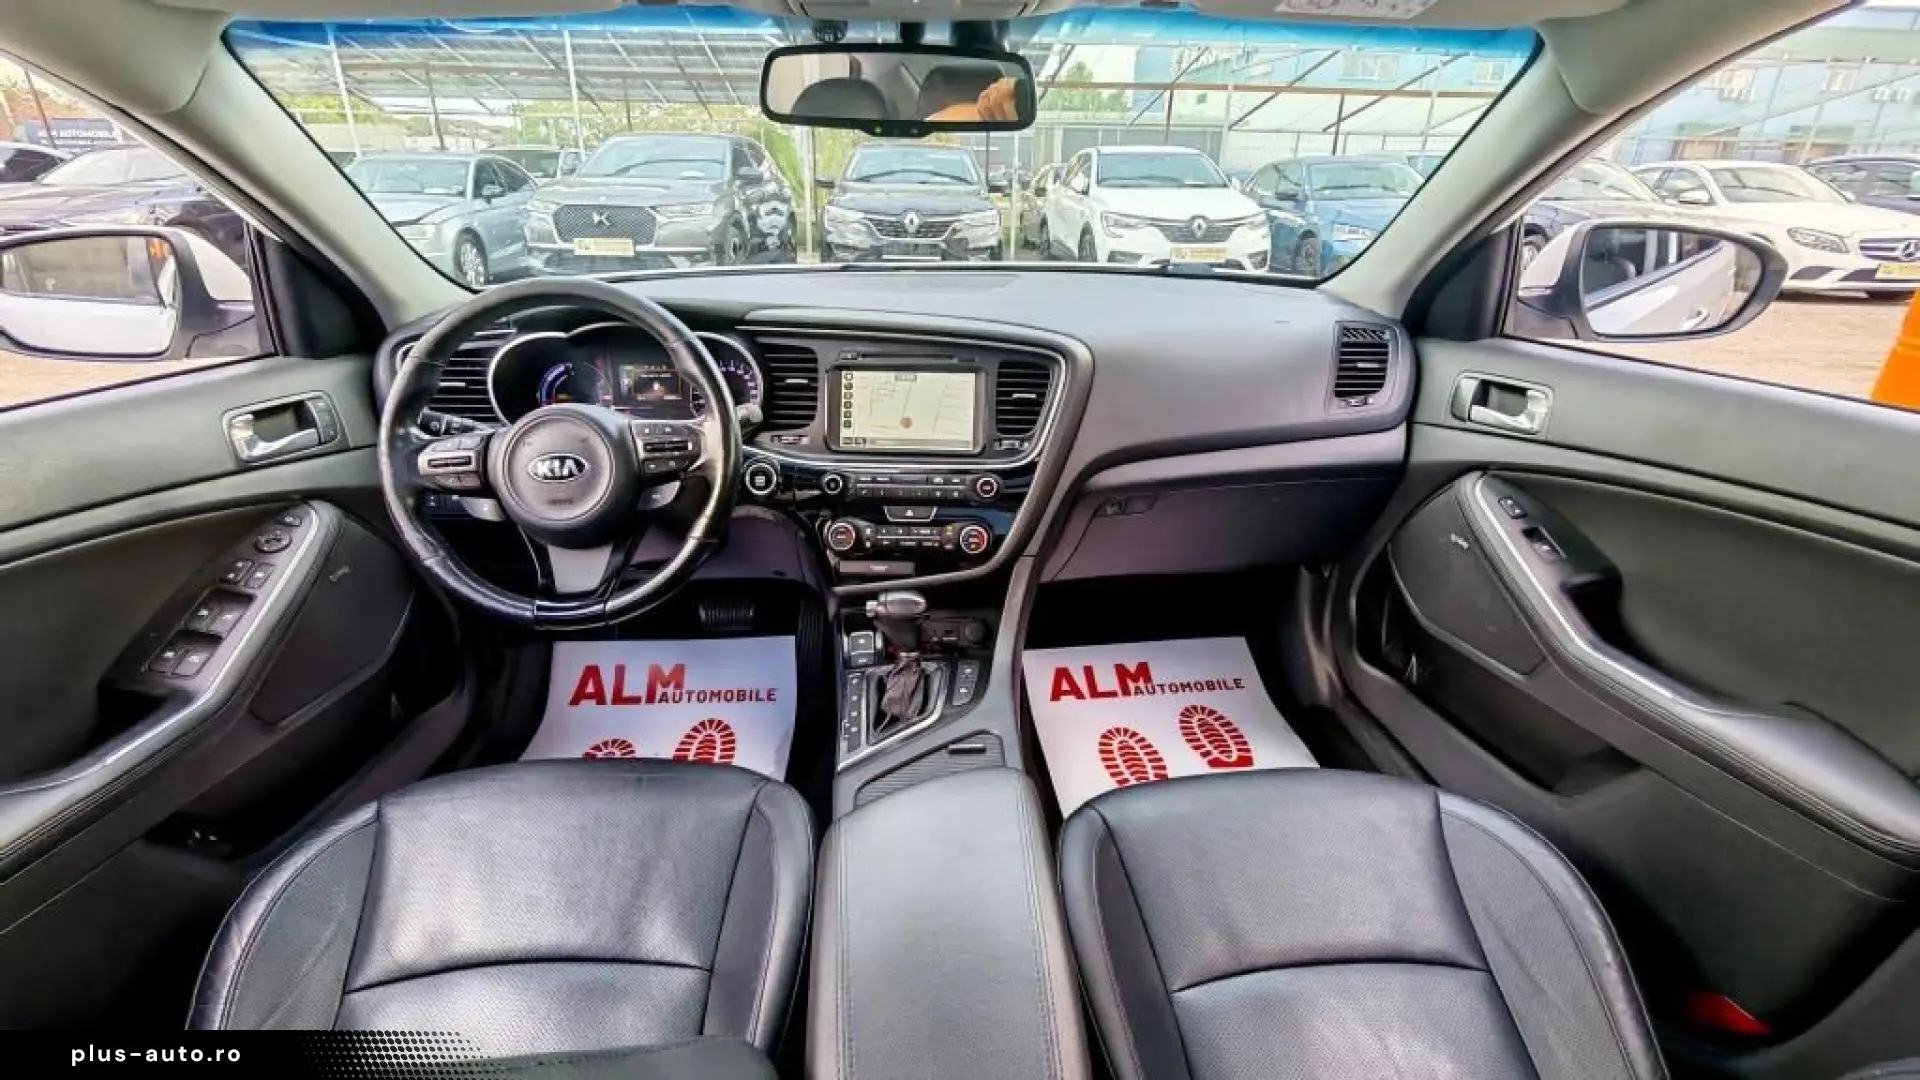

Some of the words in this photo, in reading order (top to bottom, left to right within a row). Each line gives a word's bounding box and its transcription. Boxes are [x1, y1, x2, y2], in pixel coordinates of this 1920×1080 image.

[537, 458, 579, 477] KIA
[568, 664, 685, 706] ALM
[657, 688, 777, 704] AUTOMOBILE
[1050, 662, 1152, 701] ALM
[1133, 678, 1245, 697] AUTOMOBILE
